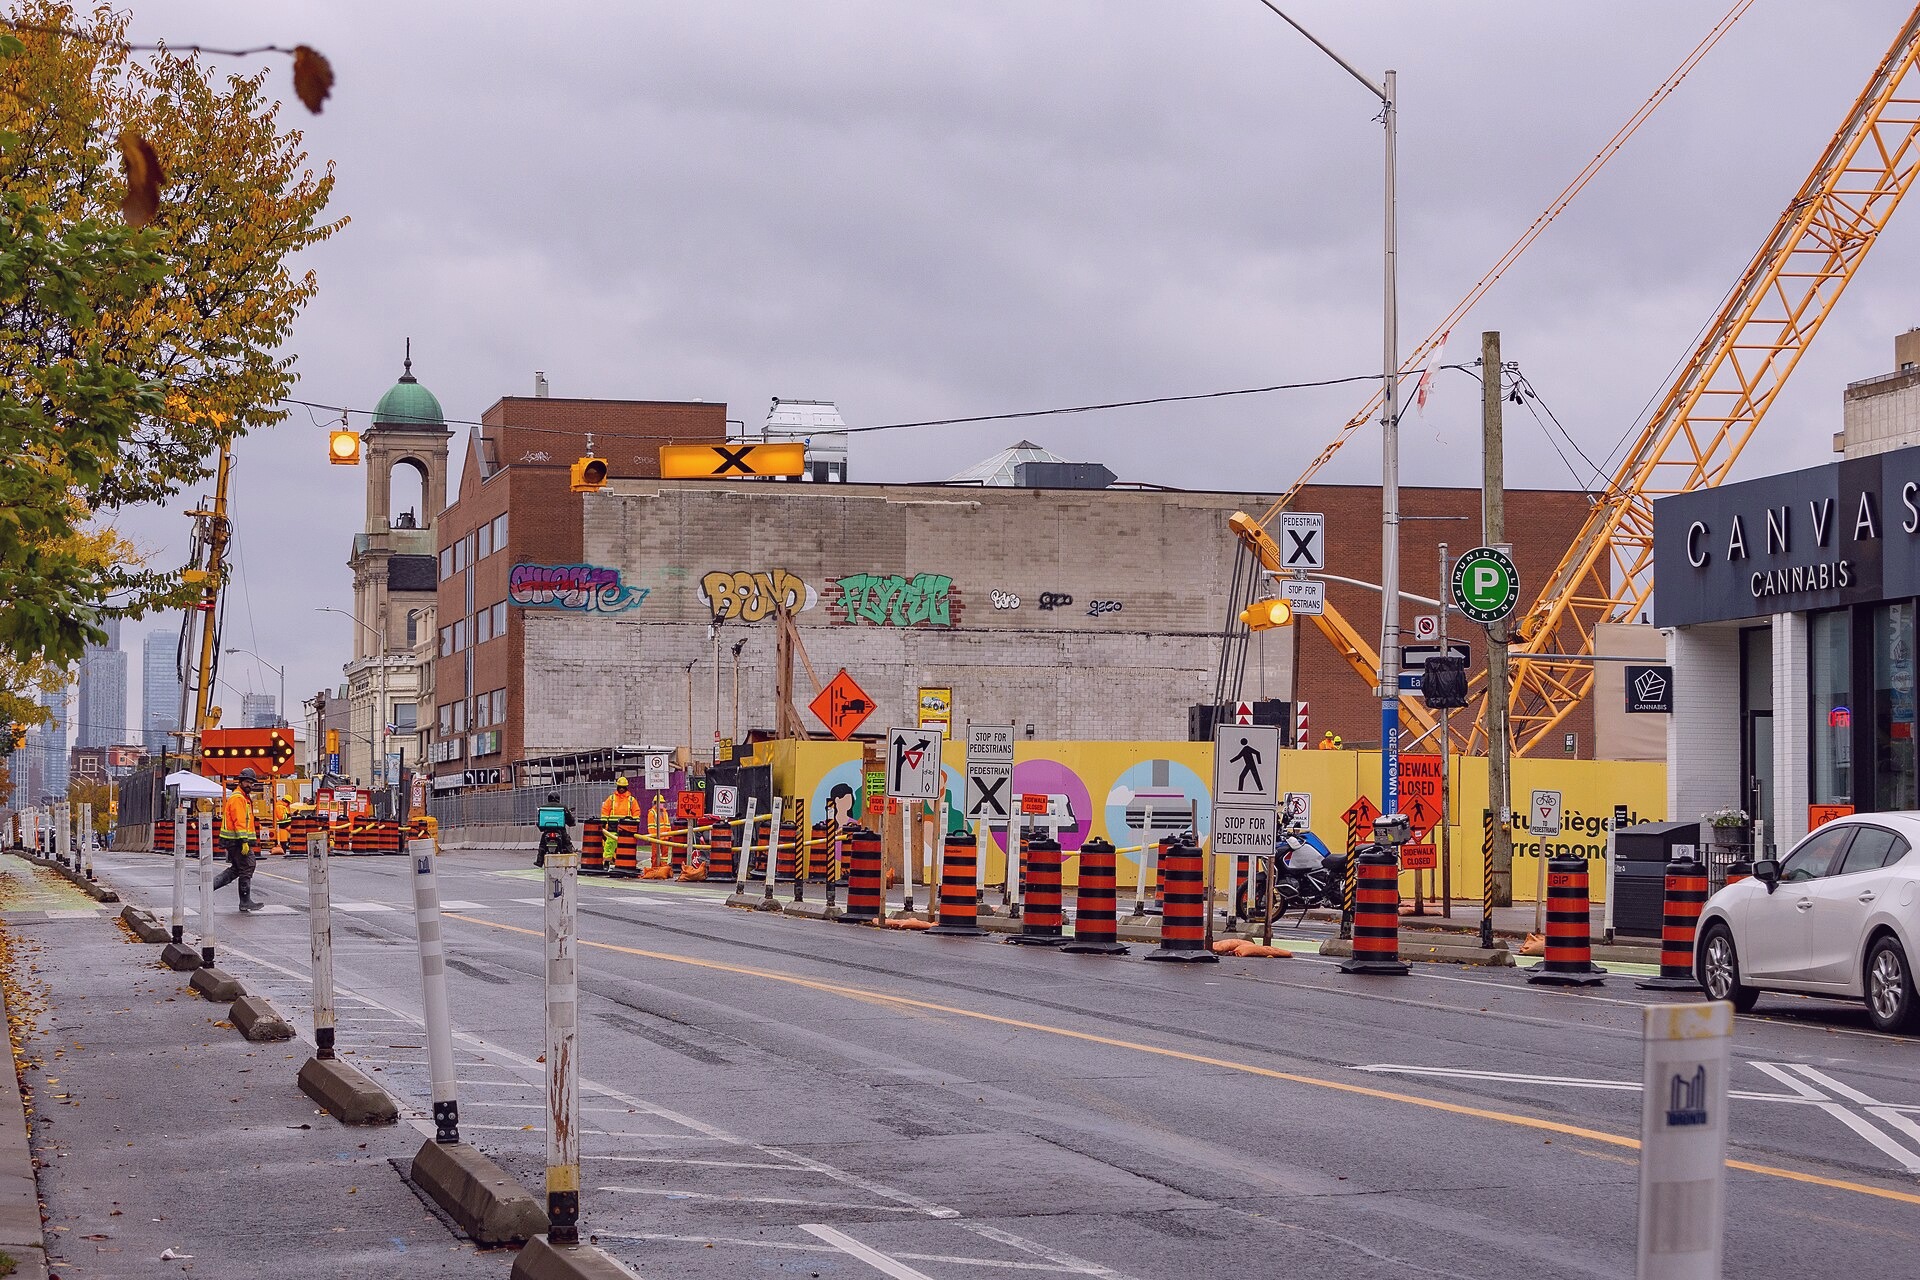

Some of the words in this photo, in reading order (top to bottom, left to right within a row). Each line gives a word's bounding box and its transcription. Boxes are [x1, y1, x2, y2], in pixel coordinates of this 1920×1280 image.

[1284, 517, 1321, 526] PEDESTRIAN
[1687, 481, 1920, 568] CANVAS
[1455, 551, 1516, 584] MUNICIPAL
[1750, 560, 1848, 598] CANNABIS
[1288, 585, 1302, 594] STOP
[1305, 586, 1316, 595] FOR
[1290, 599, 1320, 609] DESTRIANS
[1455, 590, 1516, 619] PARKING
[1828, 712, 1850, 727] OPEN
[975, 732, 991, 741] STOP
[994, 732, 1006, 742] FOR
[970, 744, 1012, 753] PEDESTRIANS
[1388, 728, 1397, 795] GREEKTOWN
[970, 767, 1009, 775] PEDESTRIAN
[1398, 762, 1440, 777] DEWALK
[1224, 816, 1245, 829] STOP
[1249, 817, 1265, 830] FOR
[1560, 810, 1609, 836] iège
[1216, 832, 1272, 846] PEDESTRIANS
[1403, 847, 1434, 857] SIDEWALK
